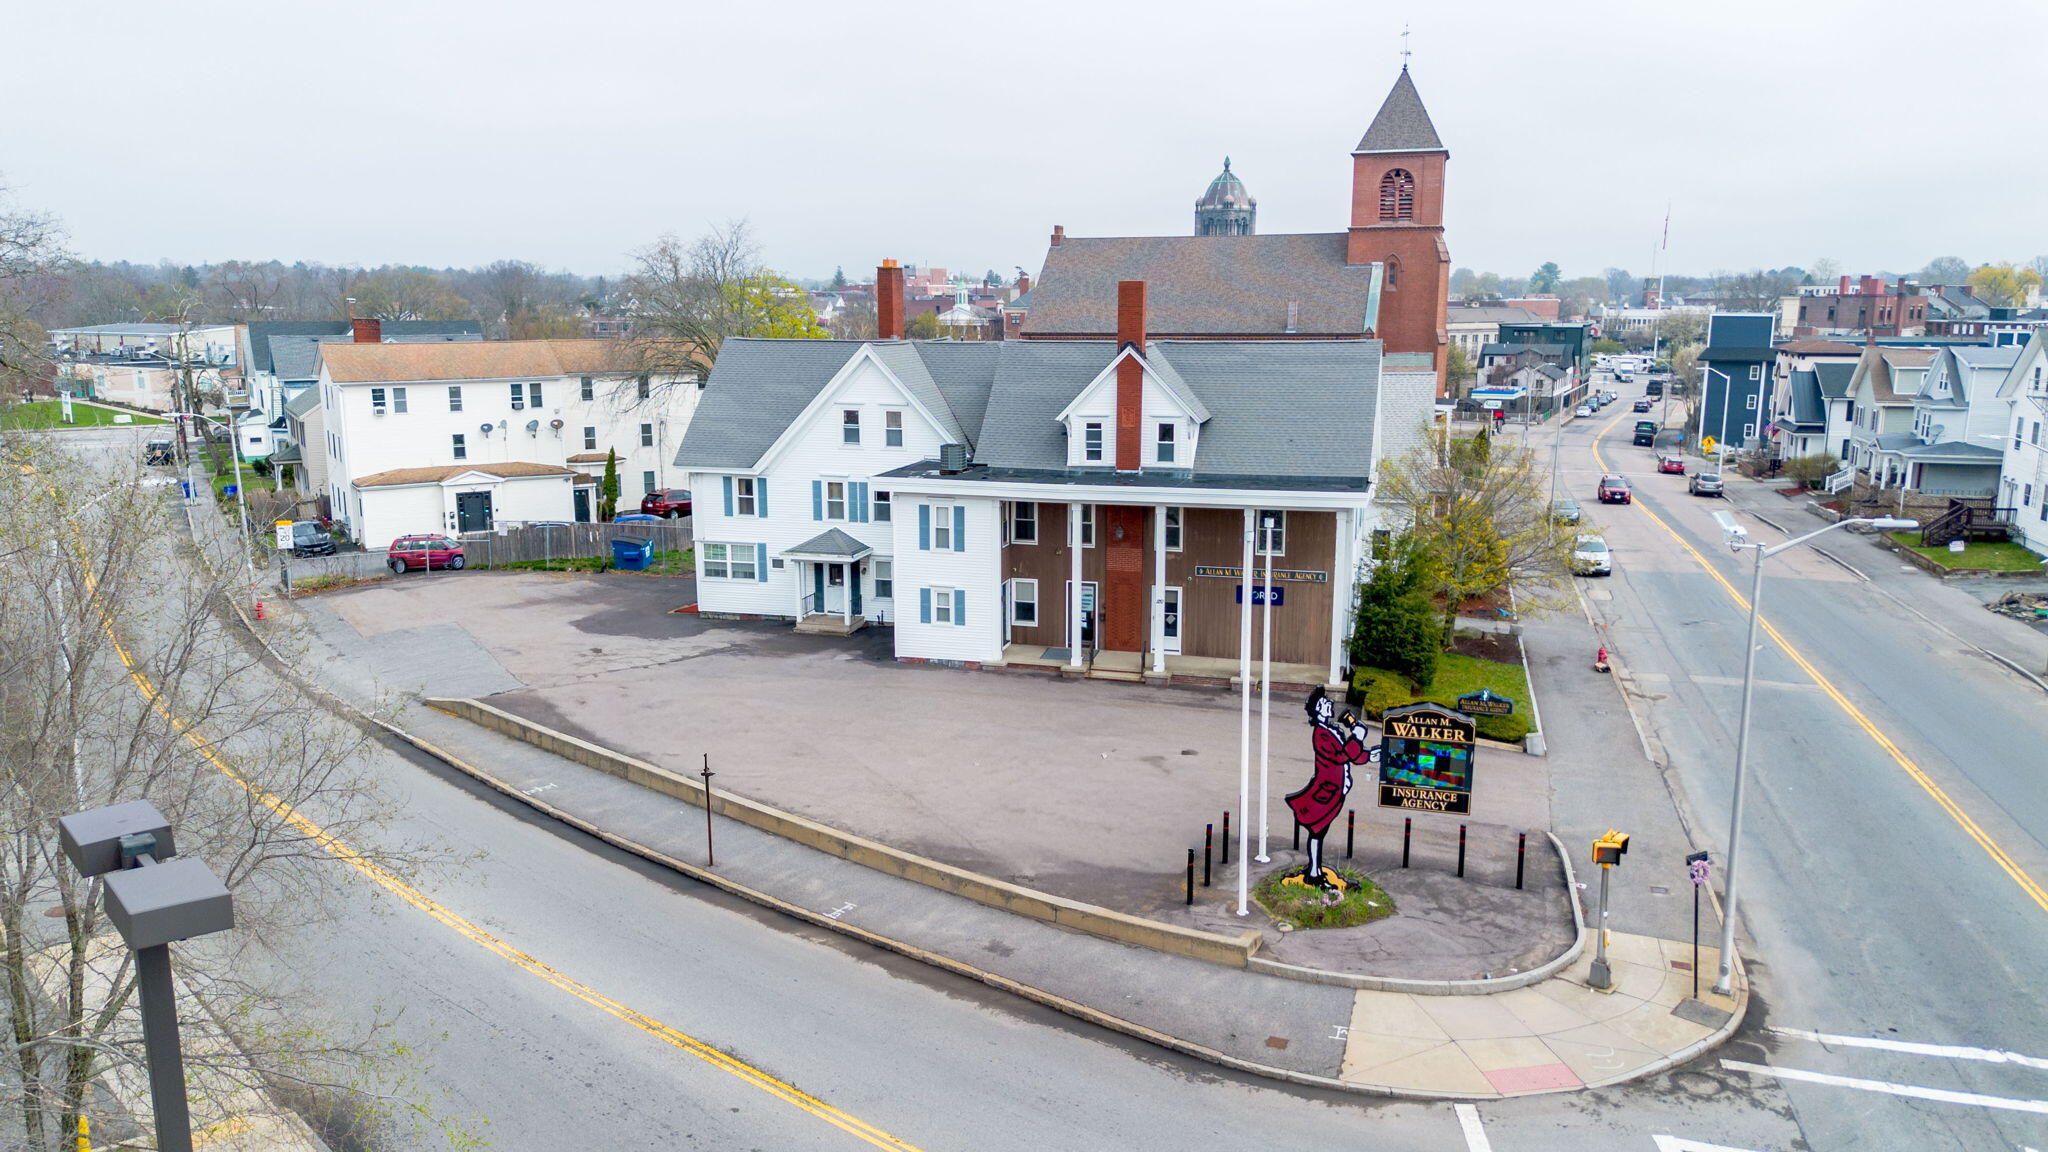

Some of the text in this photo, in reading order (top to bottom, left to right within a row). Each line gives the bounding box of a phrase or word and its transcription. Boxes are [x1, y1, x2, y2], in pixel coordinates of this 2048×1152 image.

[1295, 572, 1317, 580] AGENCY
[1407, 715, 1452, 727] ALLAN M.
[1392, 722, 1466, 742] WALKER
[1392, 787, 1458, 802] INSURANCE
[1401, 797, 1448, 811] AGENCY
